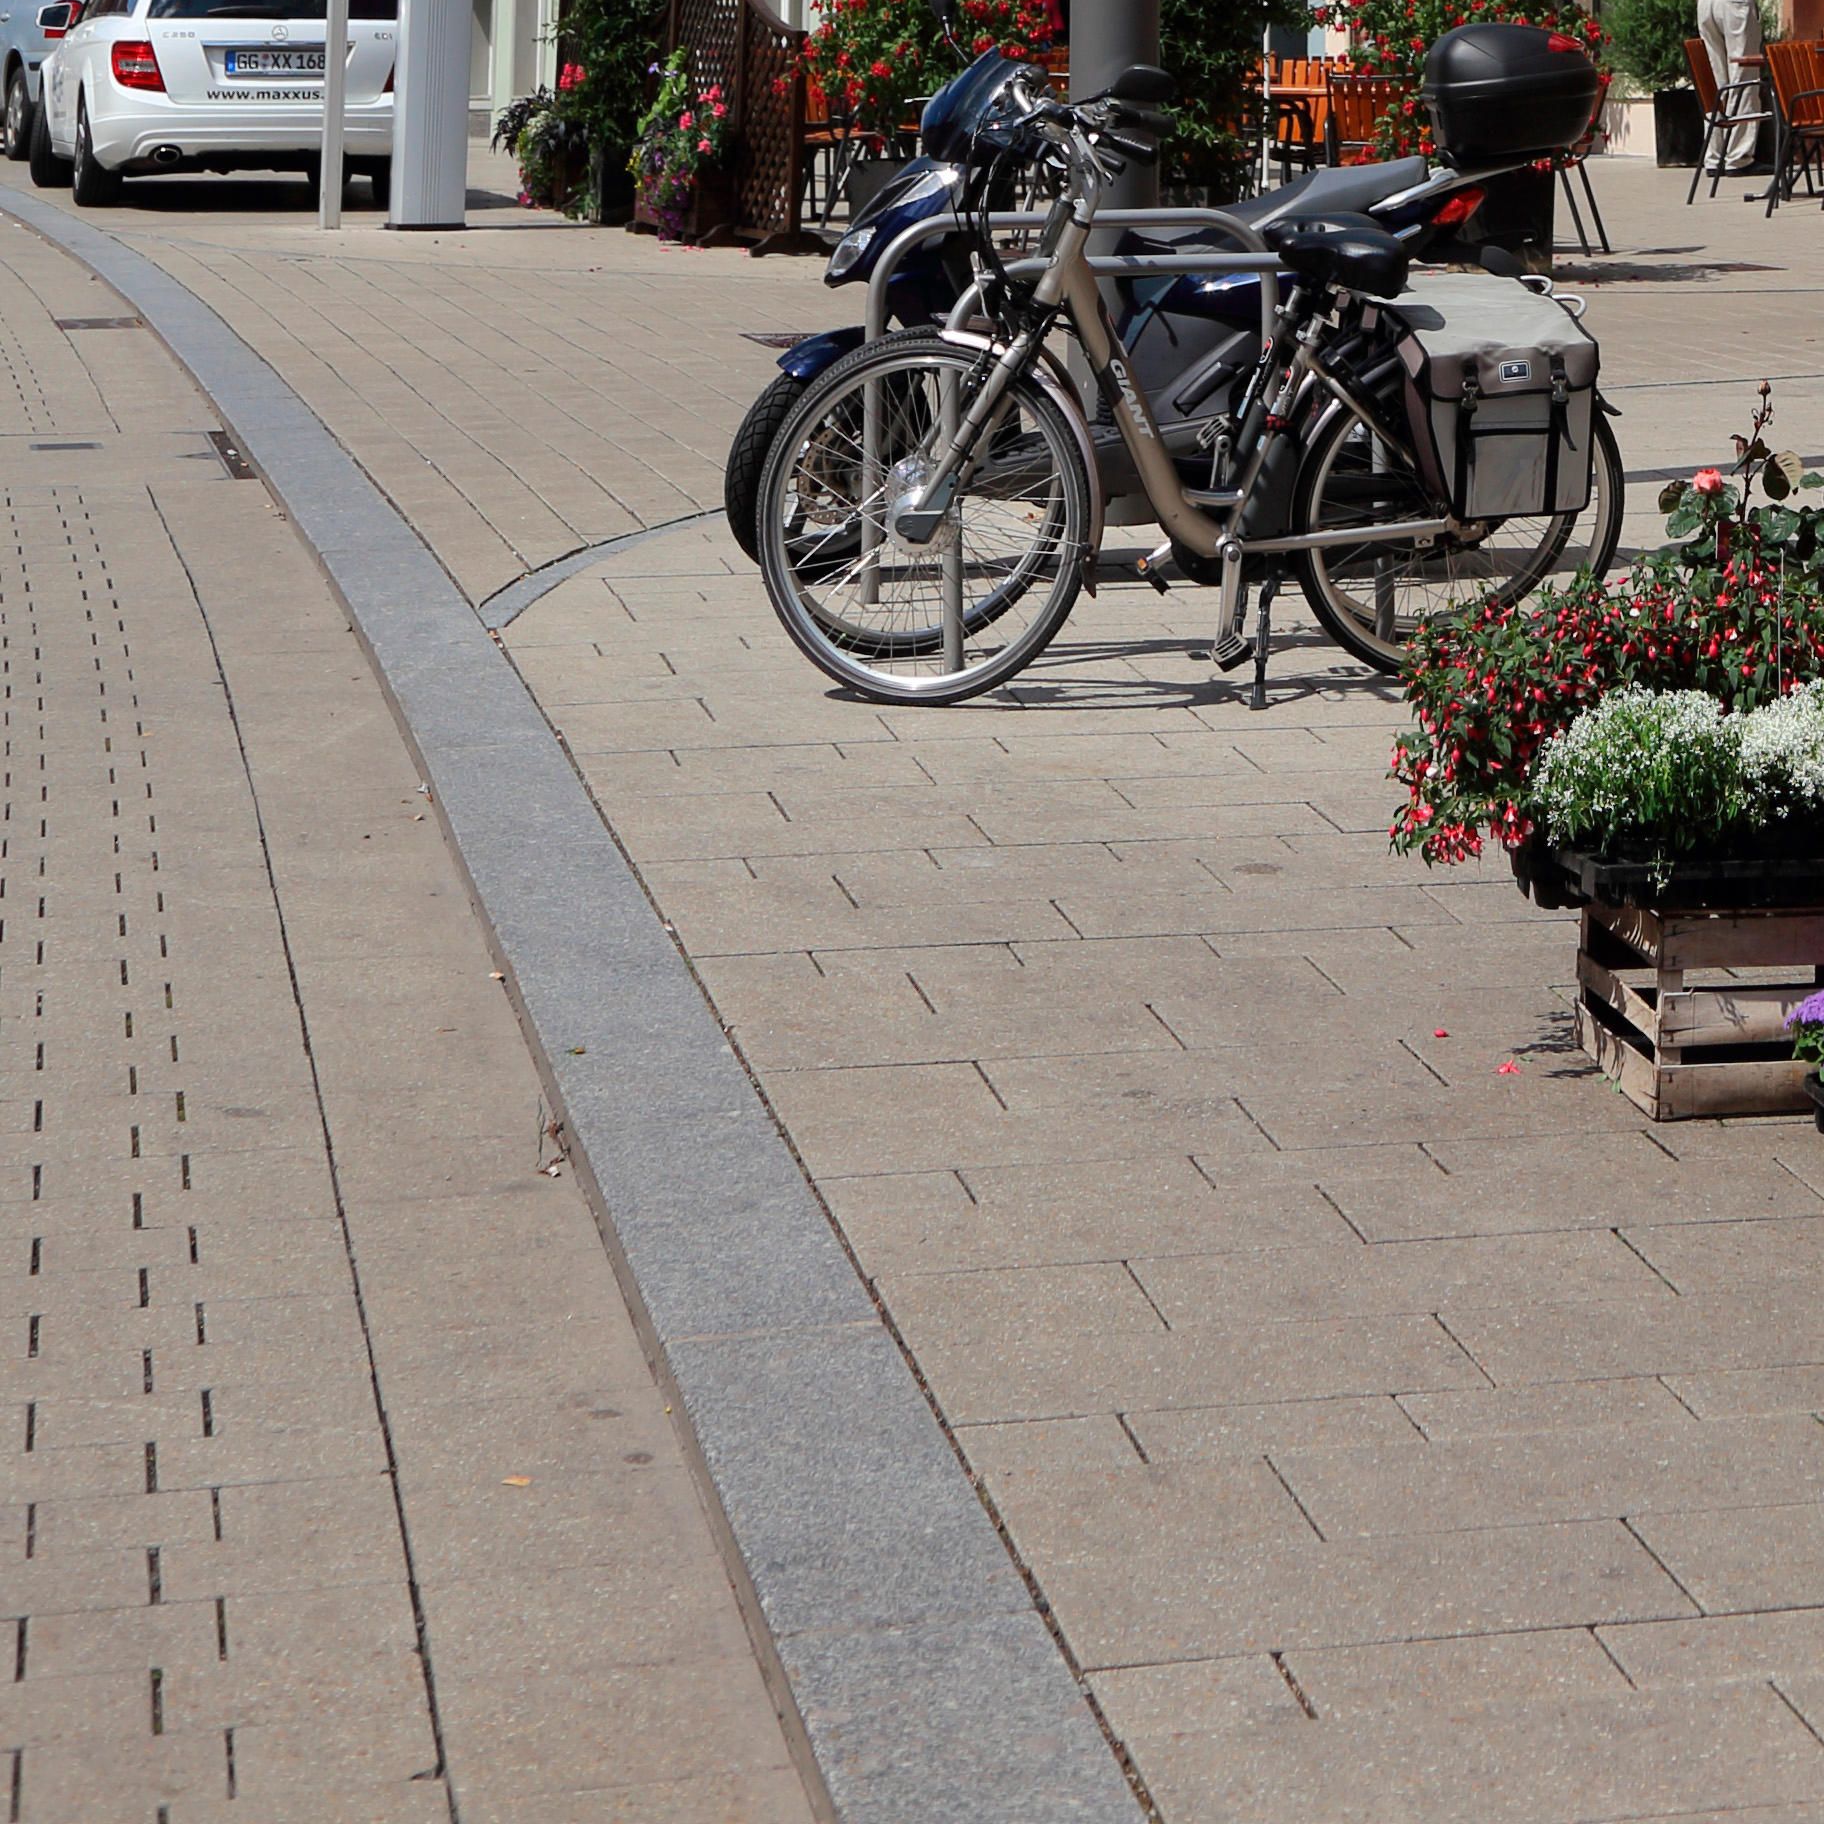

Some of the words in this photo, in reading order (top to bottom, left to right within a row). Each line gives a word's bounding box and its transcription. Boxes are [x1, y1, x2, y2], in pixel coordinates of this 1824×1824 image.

[236, 53, 259, 70] GG
[271, 53, 292, 70] XX
[207, 89, 325, 101] www.maxxus.
[1109, 359, 1156, 439] GIANT
